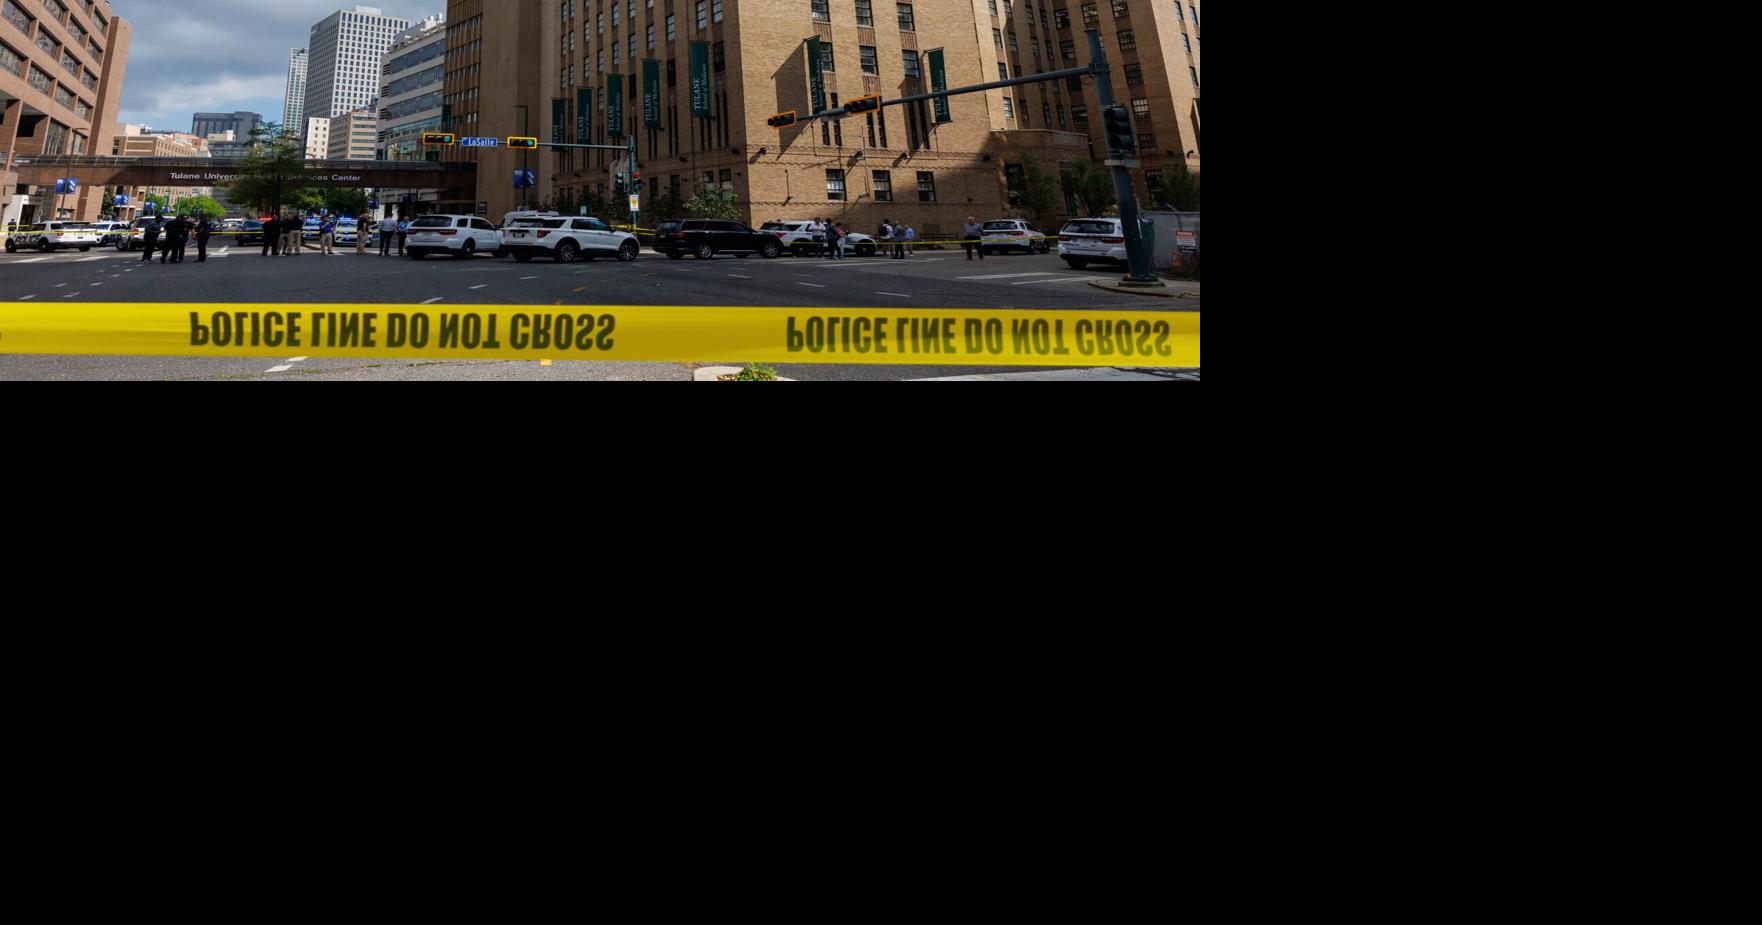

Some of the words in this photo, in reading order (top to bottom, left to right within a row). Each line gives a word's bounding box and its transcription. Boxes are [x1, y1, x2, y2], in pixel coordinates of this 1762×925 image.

[693, 78, 701, 111] TULANE
[933, 86, 942, 117] TULAE
[468, 137, 494, 146] LaSalle
[169, 172, 200, 180] Tulane
